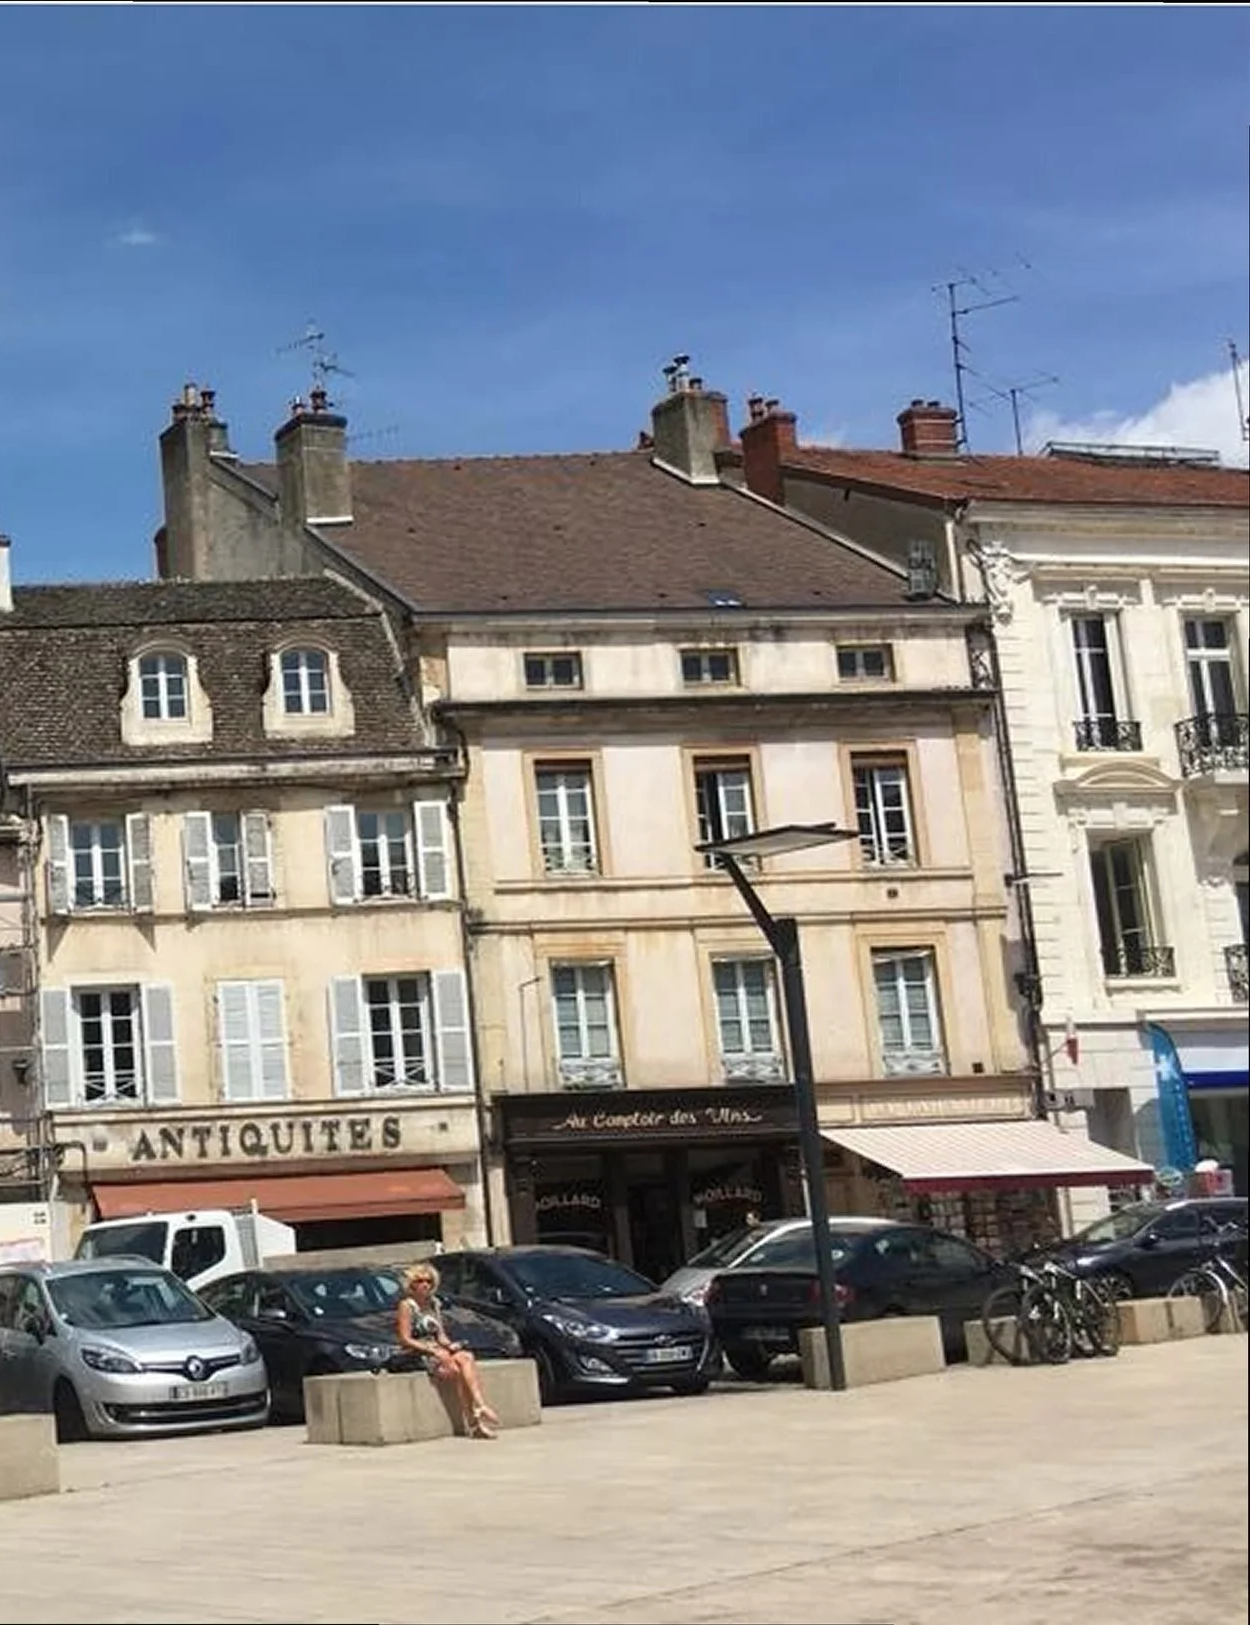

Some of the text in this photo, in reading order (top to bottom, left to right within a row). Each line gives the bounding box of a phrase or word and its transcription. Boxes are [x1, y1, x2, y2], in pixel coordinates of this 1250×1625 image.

[552, 1113, 586, 1129] Au
[593, 1110, 665, 1128] Comptoir
[669, 1108, 697, 1125] des
[131, 1117, 402, 1161] ANTIQUITES
